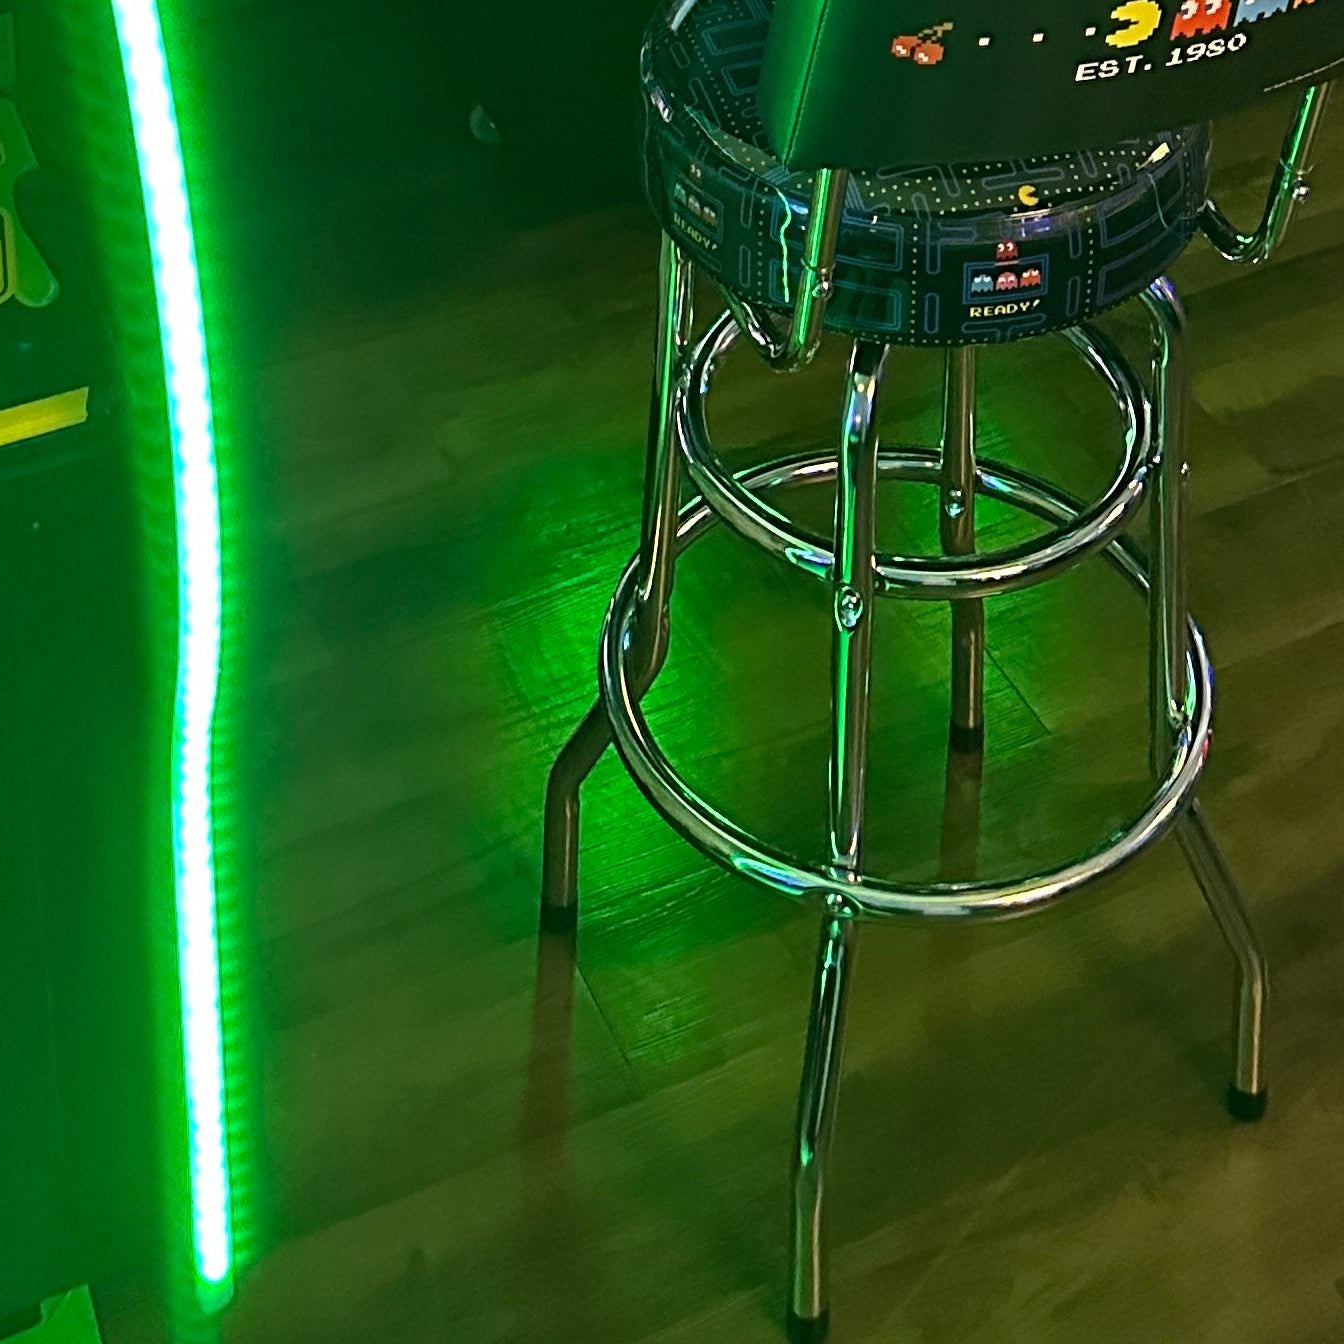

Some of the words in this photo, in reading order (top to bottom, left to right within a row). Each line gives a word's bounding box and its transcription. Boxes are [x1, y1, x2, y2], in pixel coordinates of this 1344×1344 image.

[1075, 55, 1152, 82] EST.
[1165, 32, 1247, 67] 1980
[969, 298, 1041, 318] READY!
